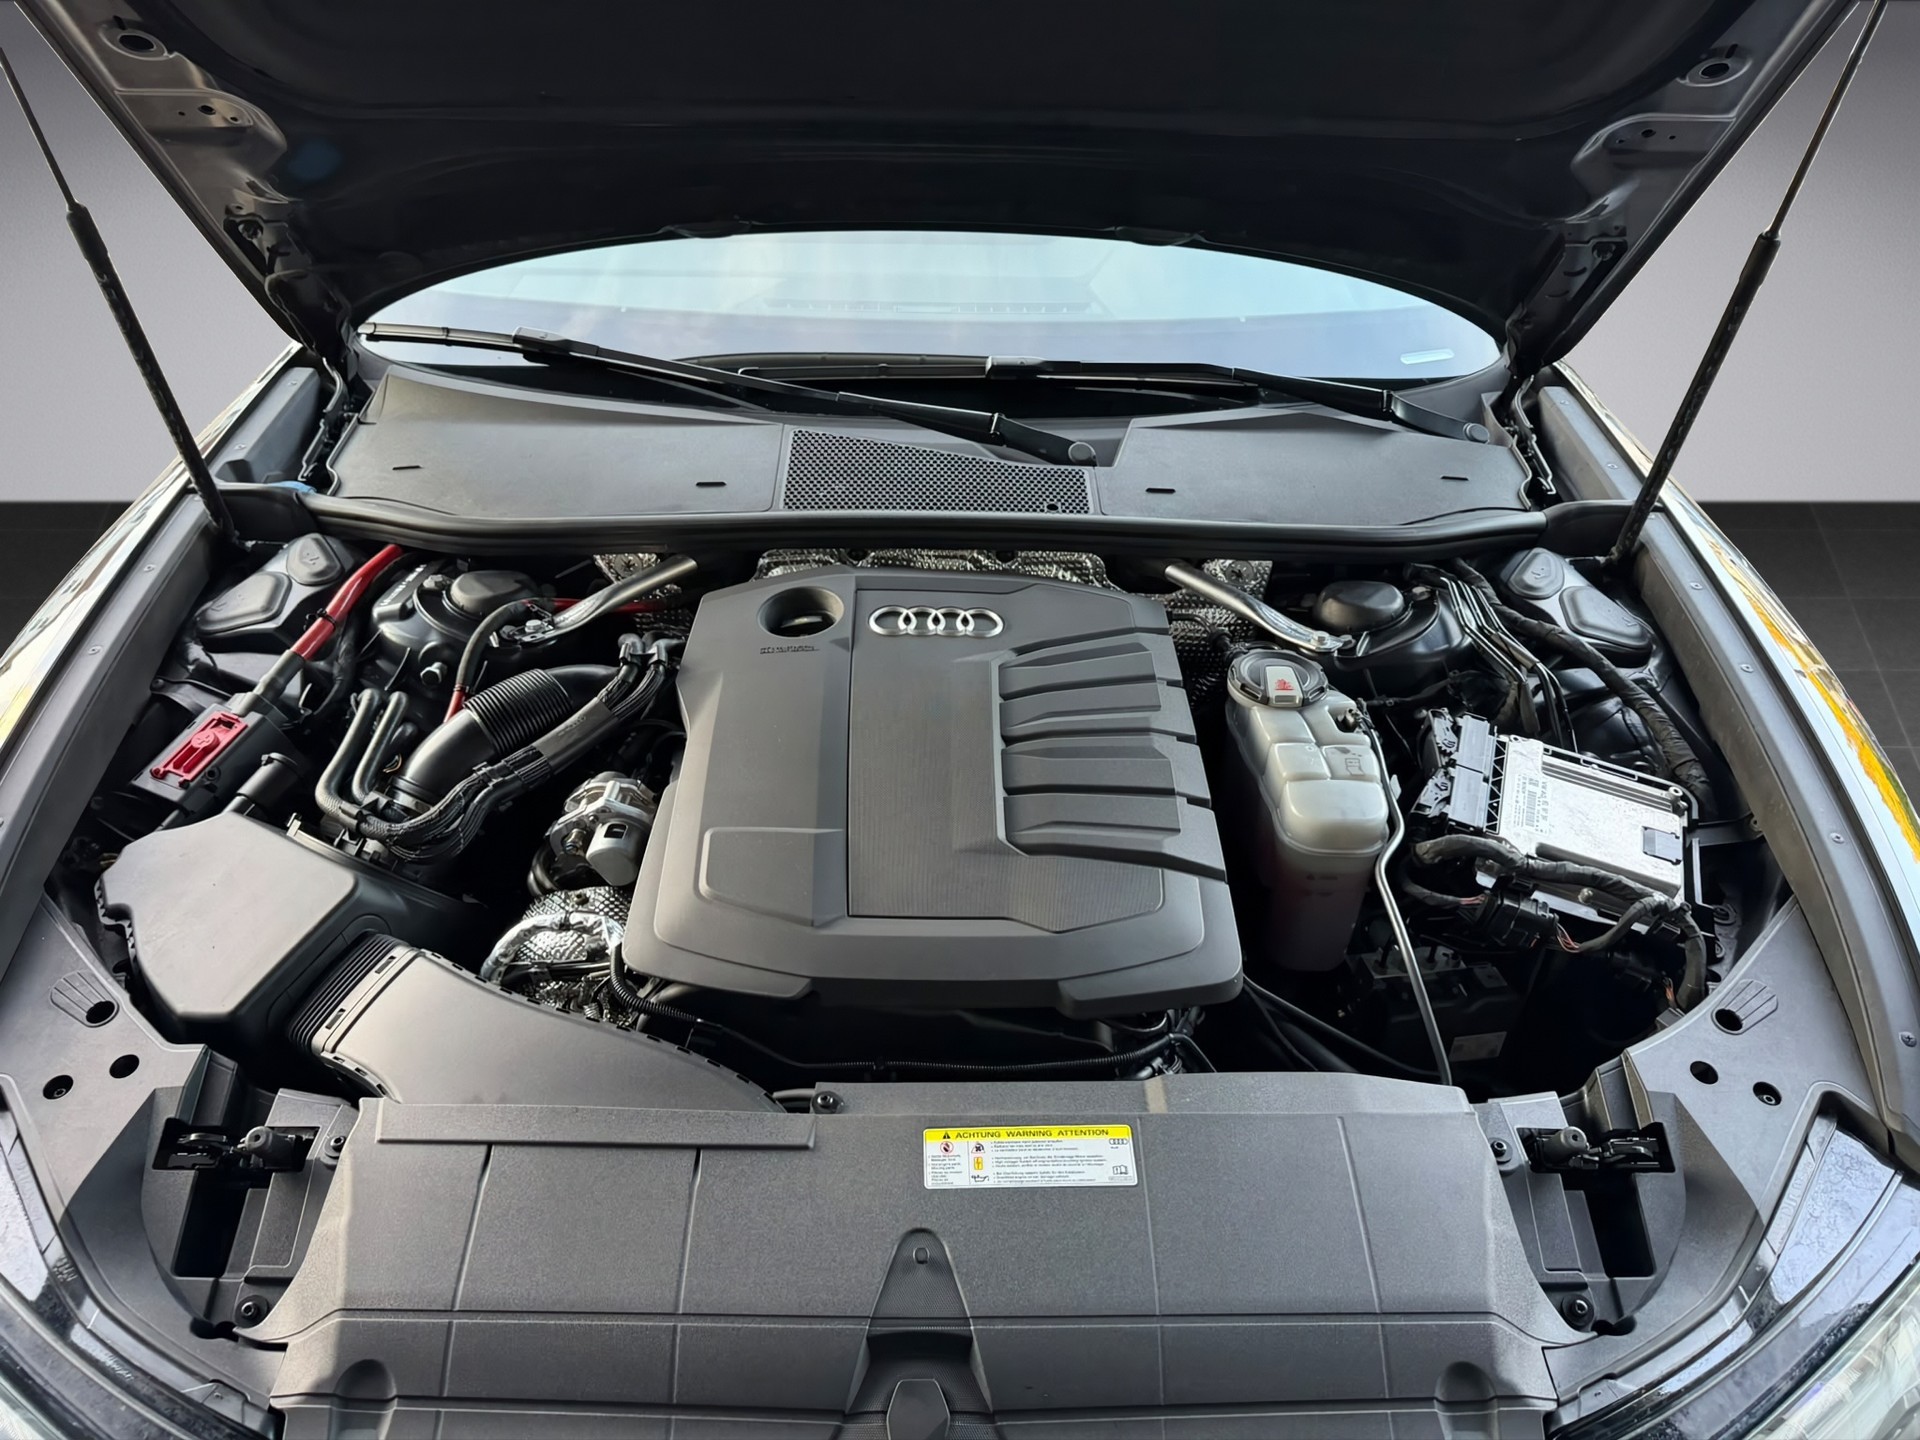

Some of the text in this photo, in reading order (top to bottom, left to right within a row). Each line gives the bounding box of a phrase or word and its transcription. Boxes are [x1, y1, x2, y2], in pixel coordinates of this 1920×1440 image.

[955, 1128, 1109, 1139] ACHTUNG WARNING ATTENTION
